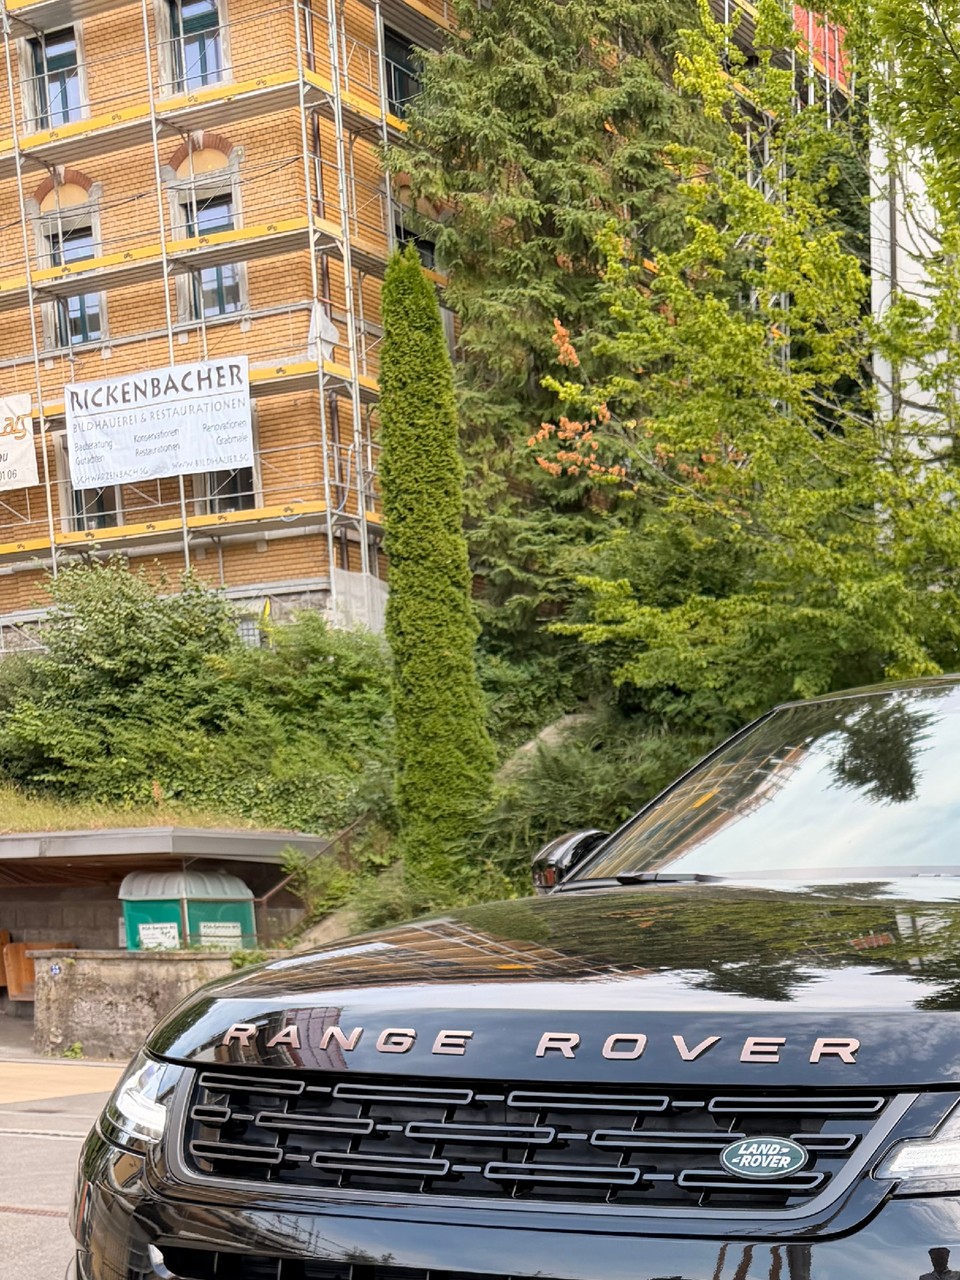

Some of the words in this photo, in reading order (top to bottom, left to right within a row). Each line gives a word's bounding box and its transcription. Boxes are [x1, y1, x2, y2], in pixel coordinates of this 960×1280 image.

[70, 364, 243, 412] RICKENBACHER
[73, 414, 138, 434] BILDHAUEREI
[149, 397, 246, 421] RESTAURATIONEN
[222, 1023, 475, 1055] RANGE
[535, 1031, 861, 1063] ROVER
[738, 1143, 781, 1155] LAND
[739, 1155, 791, 1168] ROVER
